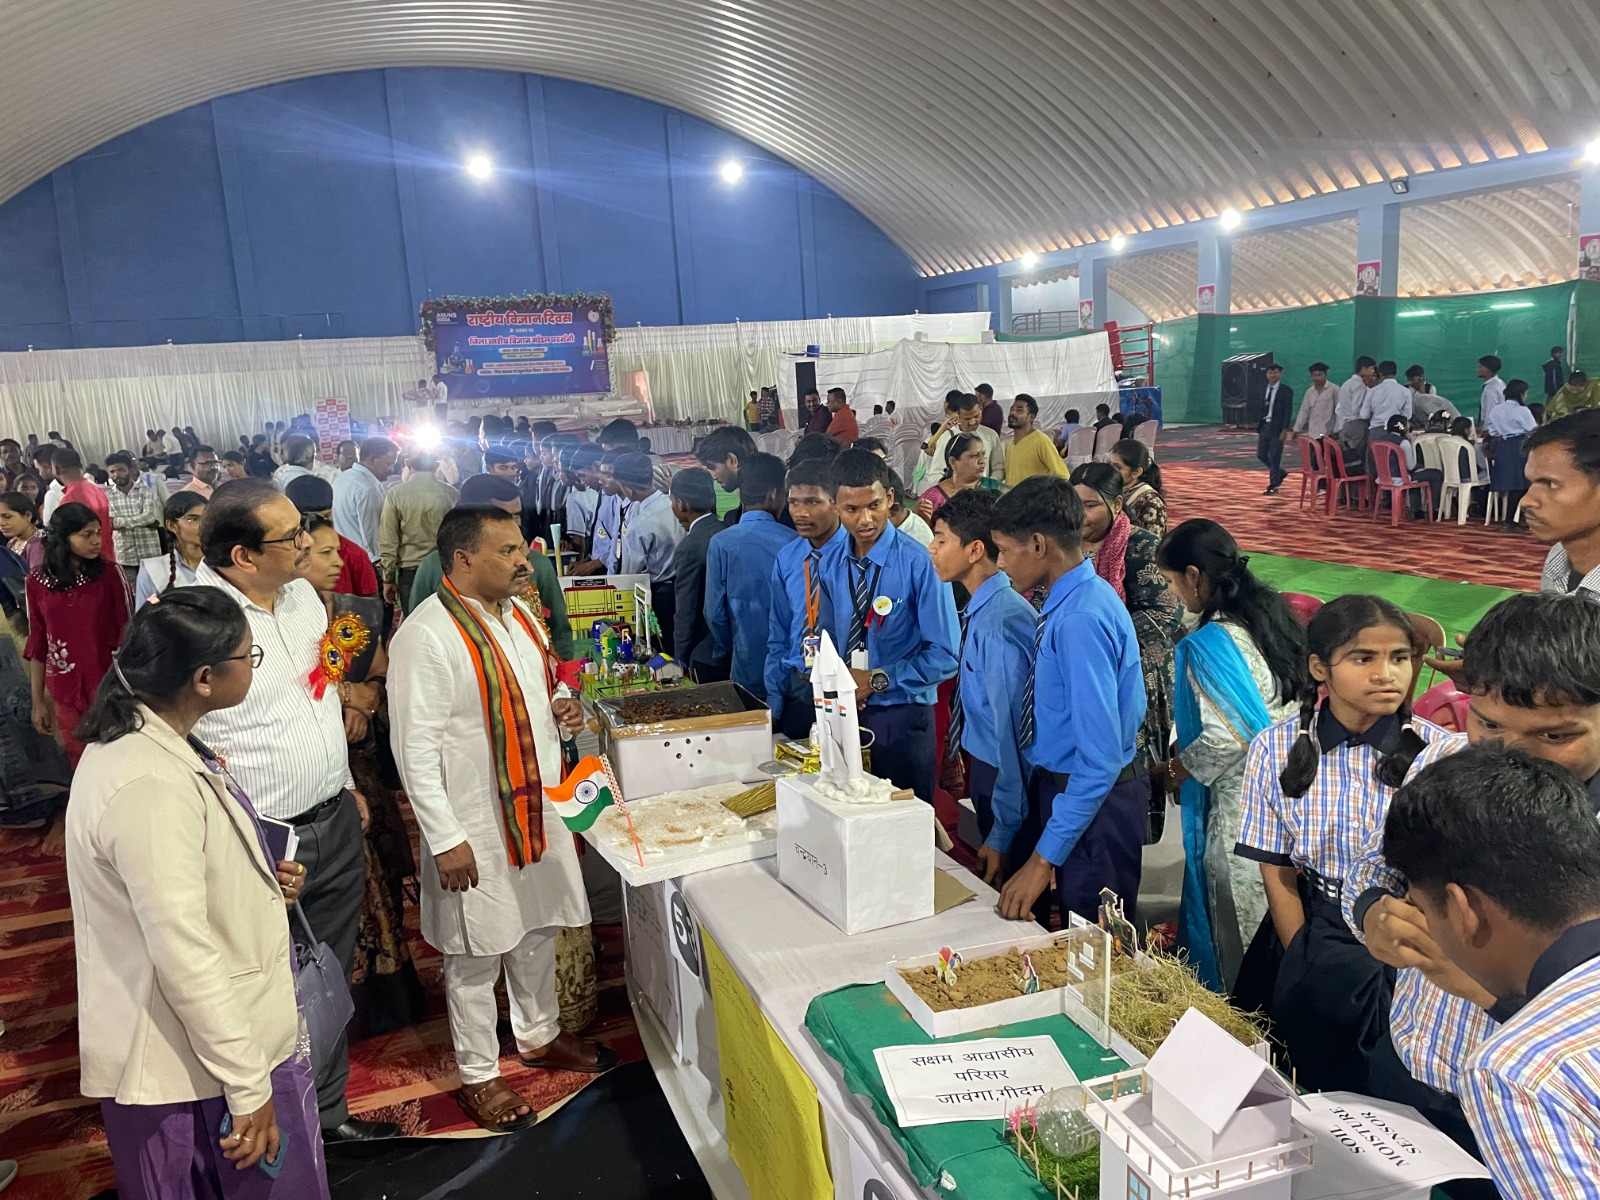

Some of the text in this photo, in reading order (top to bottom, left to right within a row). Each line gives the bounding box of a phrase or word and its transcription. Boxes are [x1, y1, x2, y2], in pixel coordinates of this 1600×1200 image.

[467, 309, 572, 327] राष्ट्रीय विज्ञान दिवस
[468, 336, 488, 346] जिला
[488, 335, 509, 345] स्तरीय
[509, 335, 531, 345] विज्ञान
[909, 1047, 1035, 1067] सक्षम आवासीय
[953, 1068, 1010, 1082] परिसर
[1329, 1106, 1411, 1167] MOISTURE
[1329, 1124, 1366, 1155] SOIL
[1360, 1111, 1422, 1154] SENSOR
